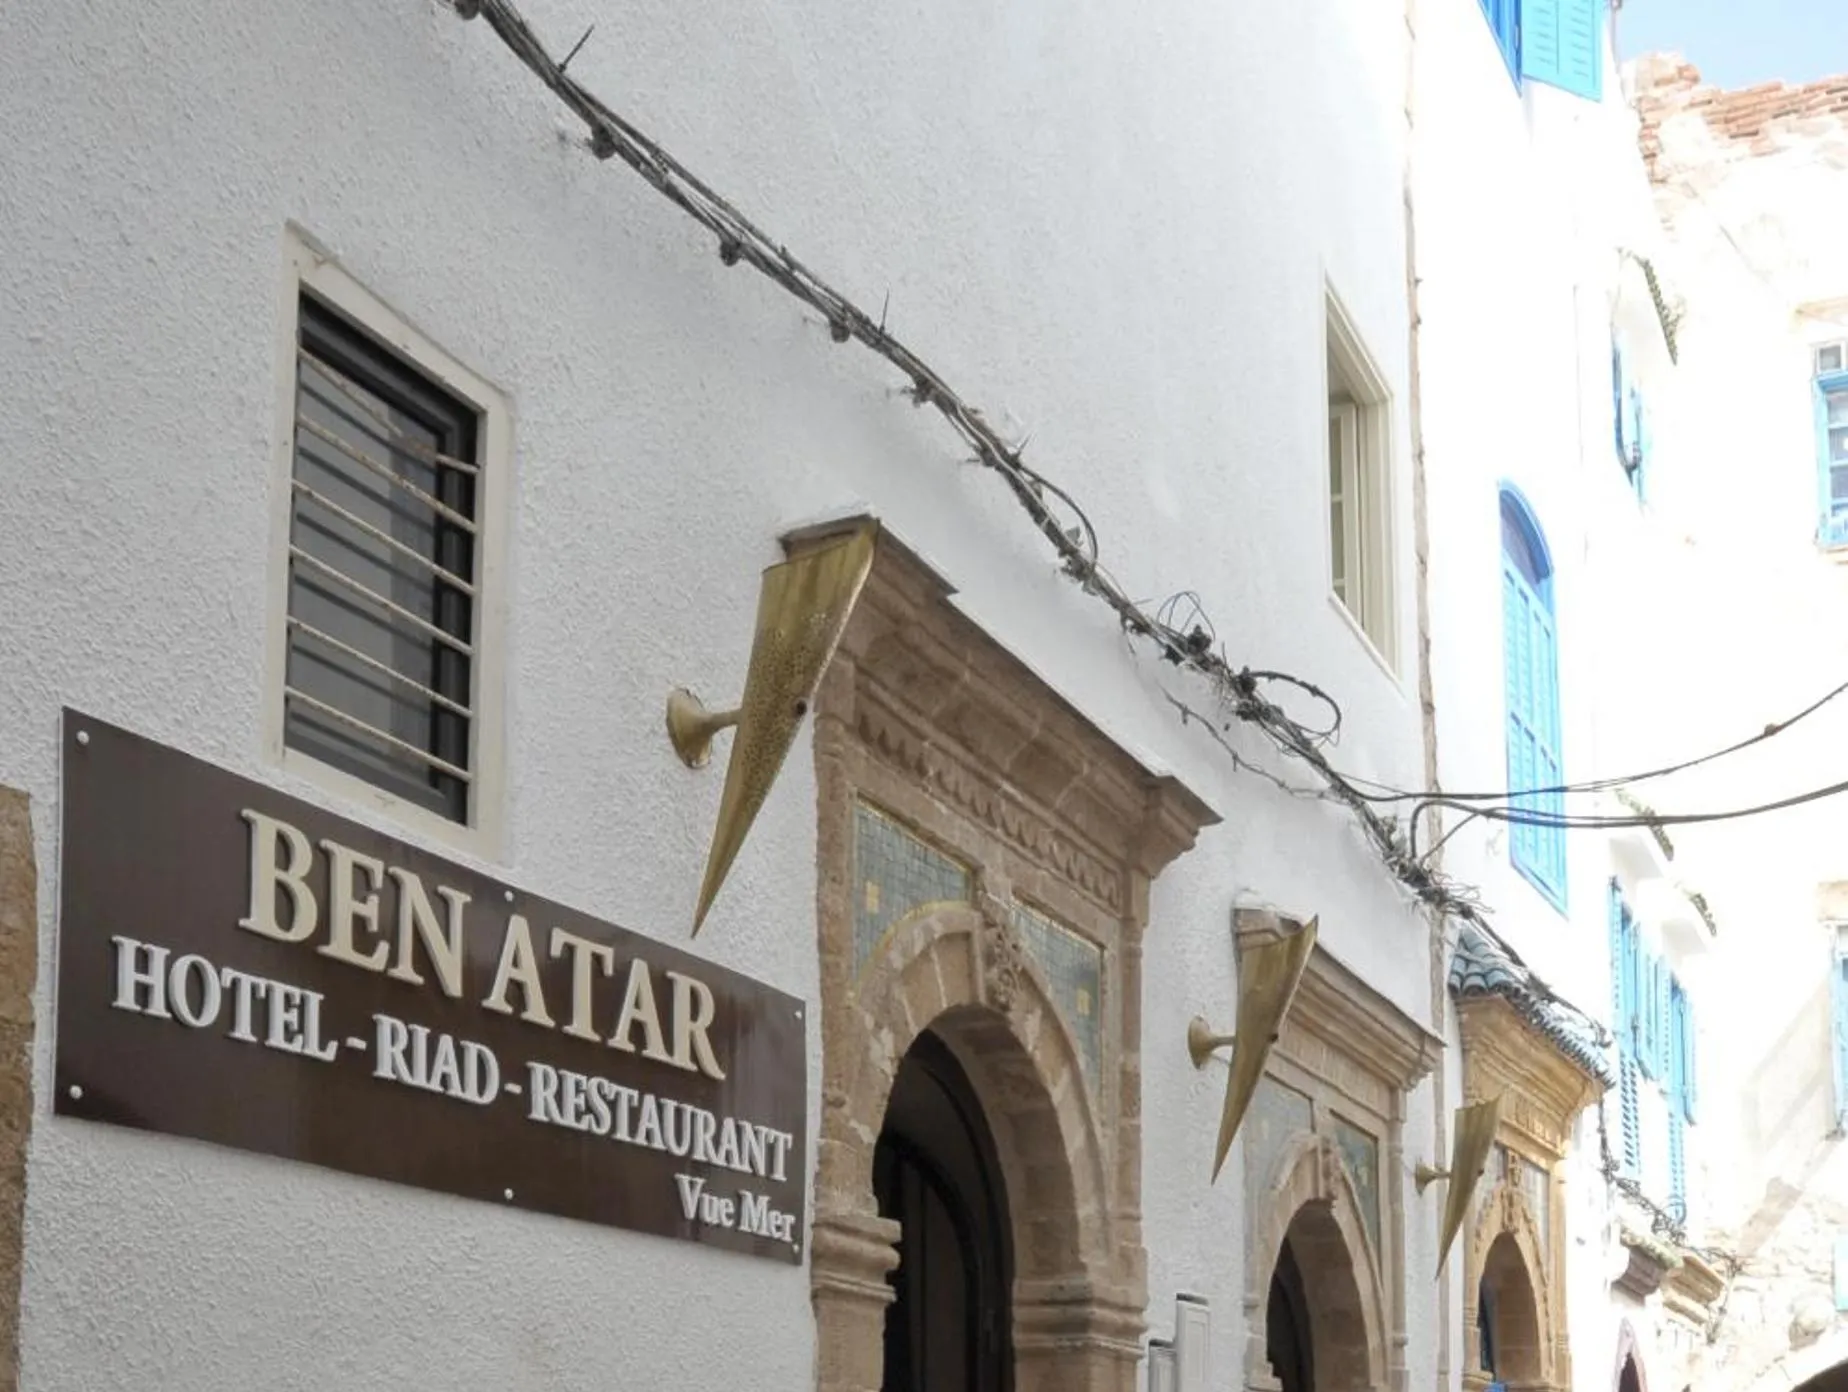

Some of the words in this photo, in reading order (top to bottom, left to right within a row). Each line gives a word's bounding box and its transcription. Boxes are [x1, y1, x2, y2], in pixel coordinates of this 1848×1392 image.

[111, 936, 338, 1062] HOTEL
[373, 1014, 499, 1105] RIAD
[527, 1062, 792, 1181] RESTAURANT
[239, 808, 472, 998] BEN
[483, 914, 726, 1081] ATAR
[675, 1174, 734, 1228] Vue
[739, 1190, 796, 1242] Mer
